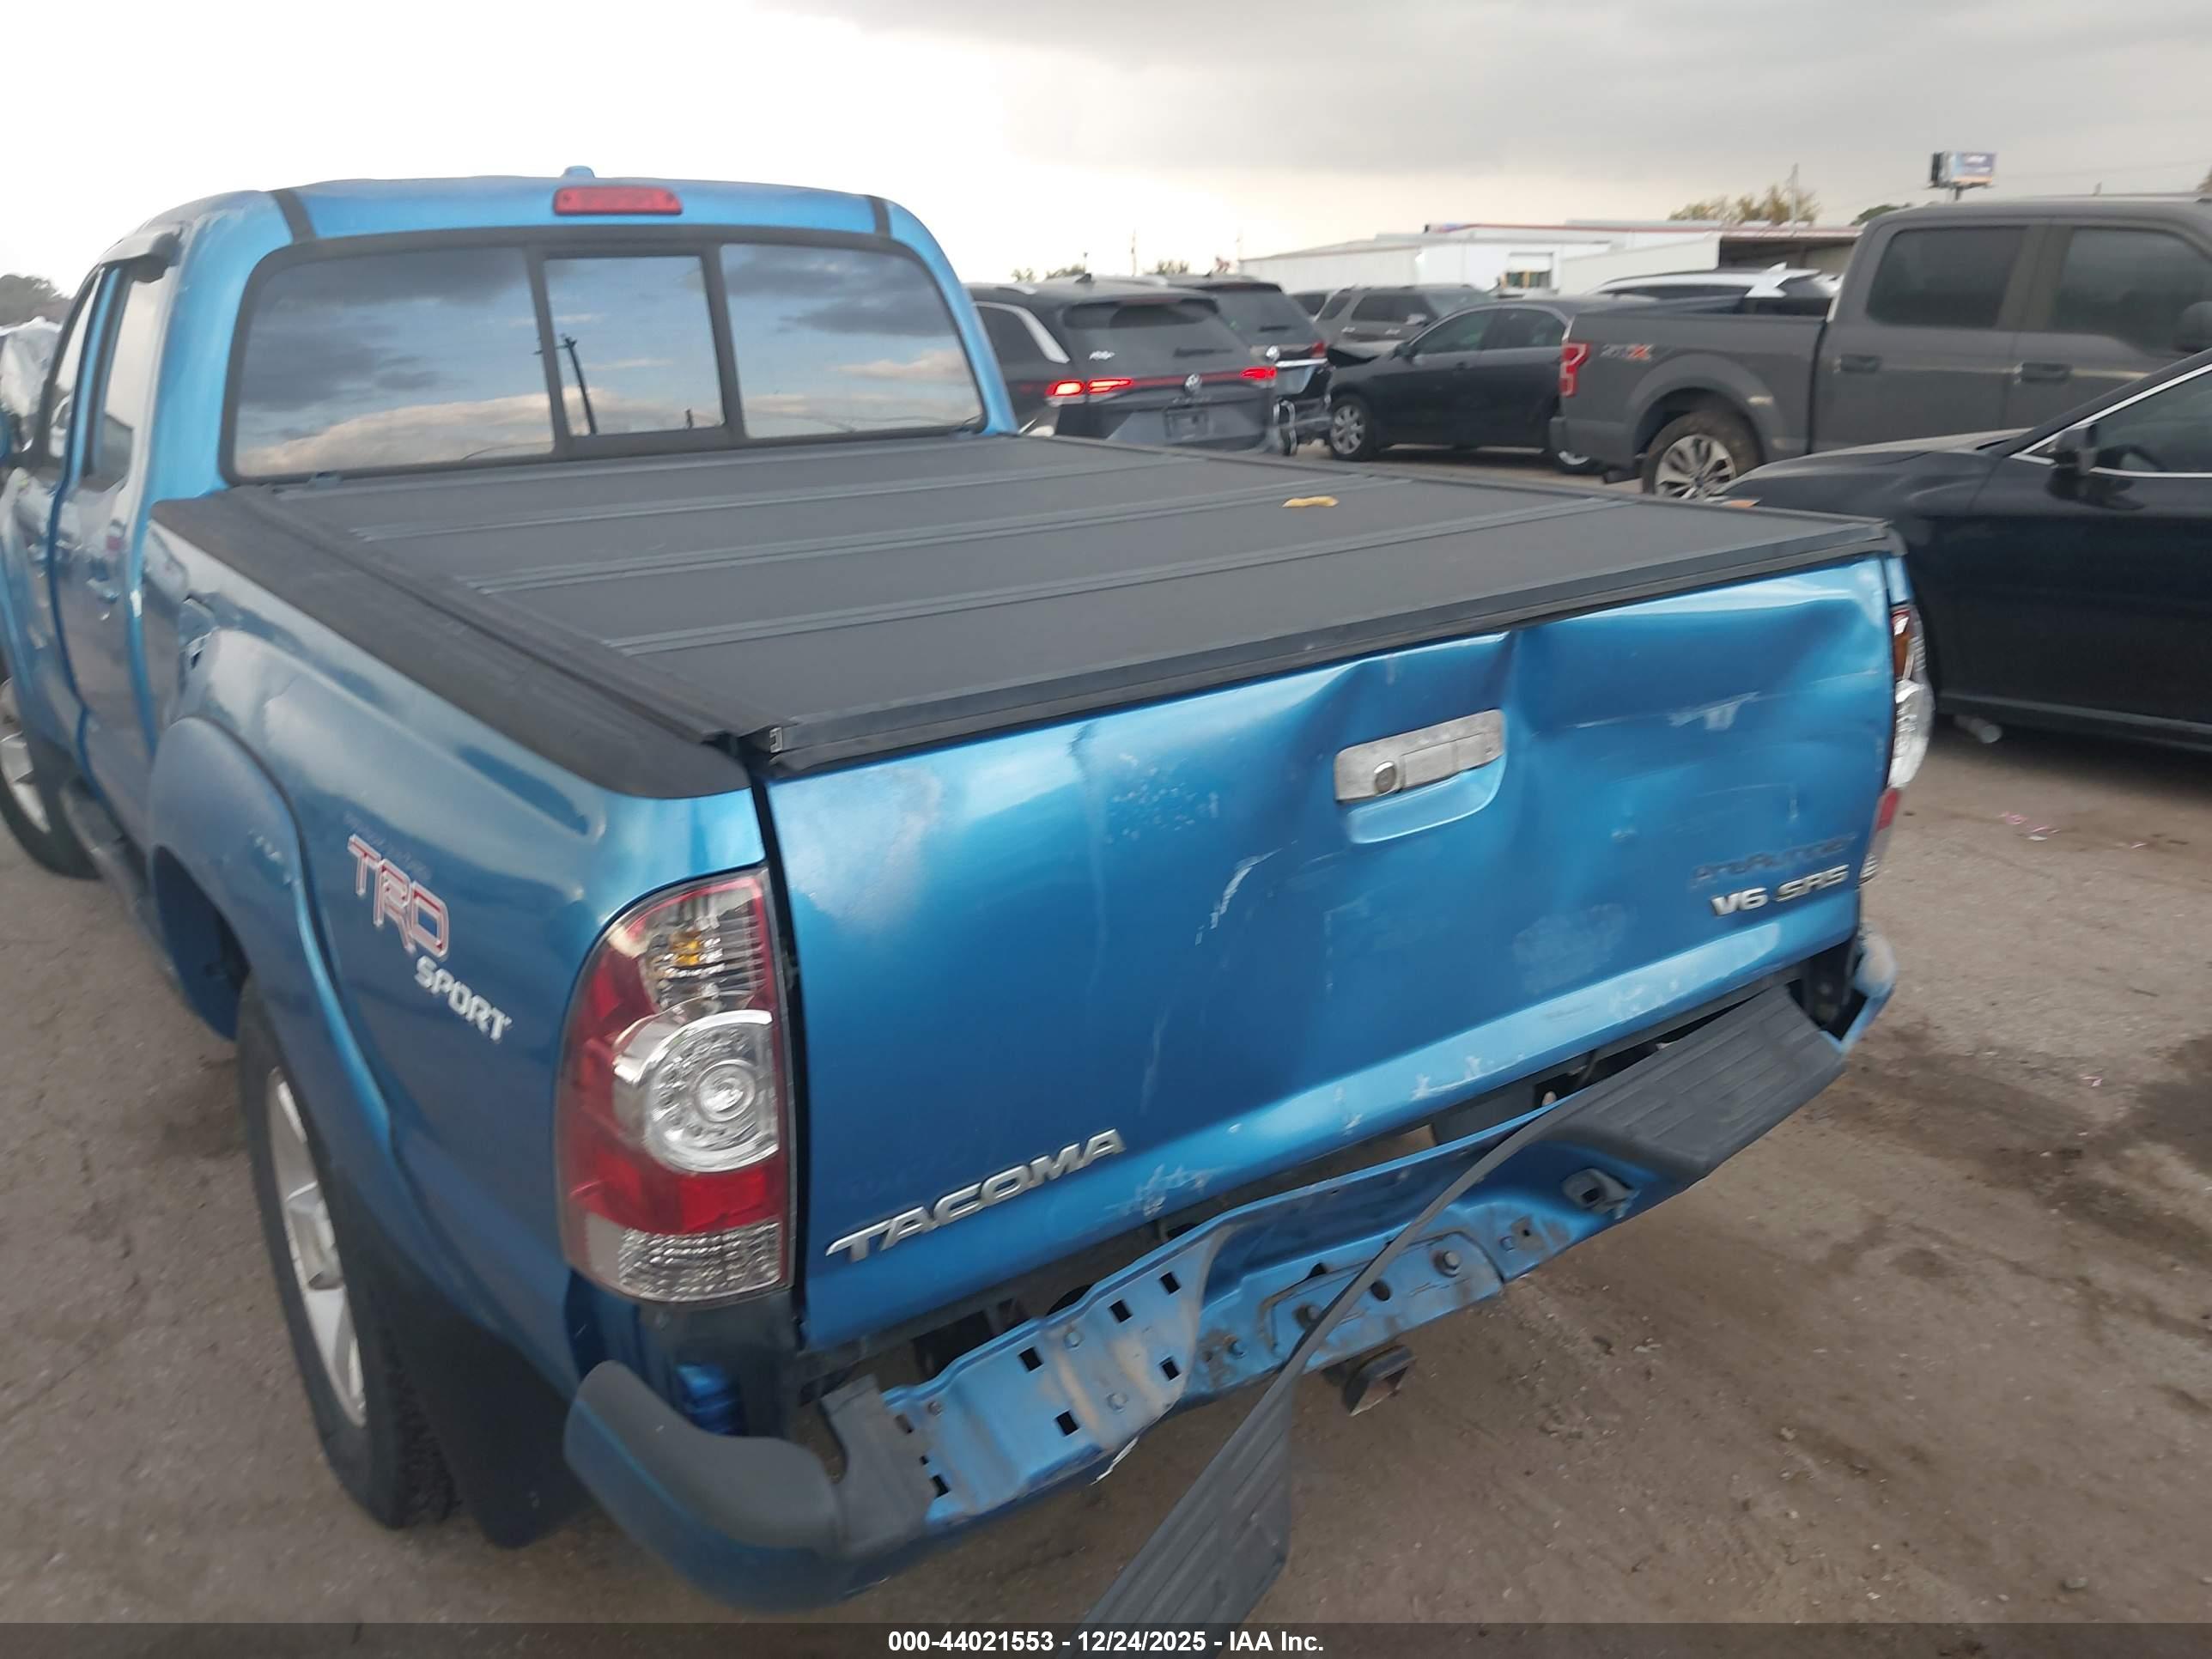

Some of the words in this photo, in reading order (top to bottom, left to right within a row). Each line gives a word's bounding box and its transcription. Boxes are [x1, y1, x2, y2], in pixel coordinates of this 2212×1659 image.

[347, 833, 450, 962] TRD
[1711, 886, 1769, 917] V6
[415, 955, 513, 1044] SPORT
[824, 1127, 1127, 1263] TACOMA
